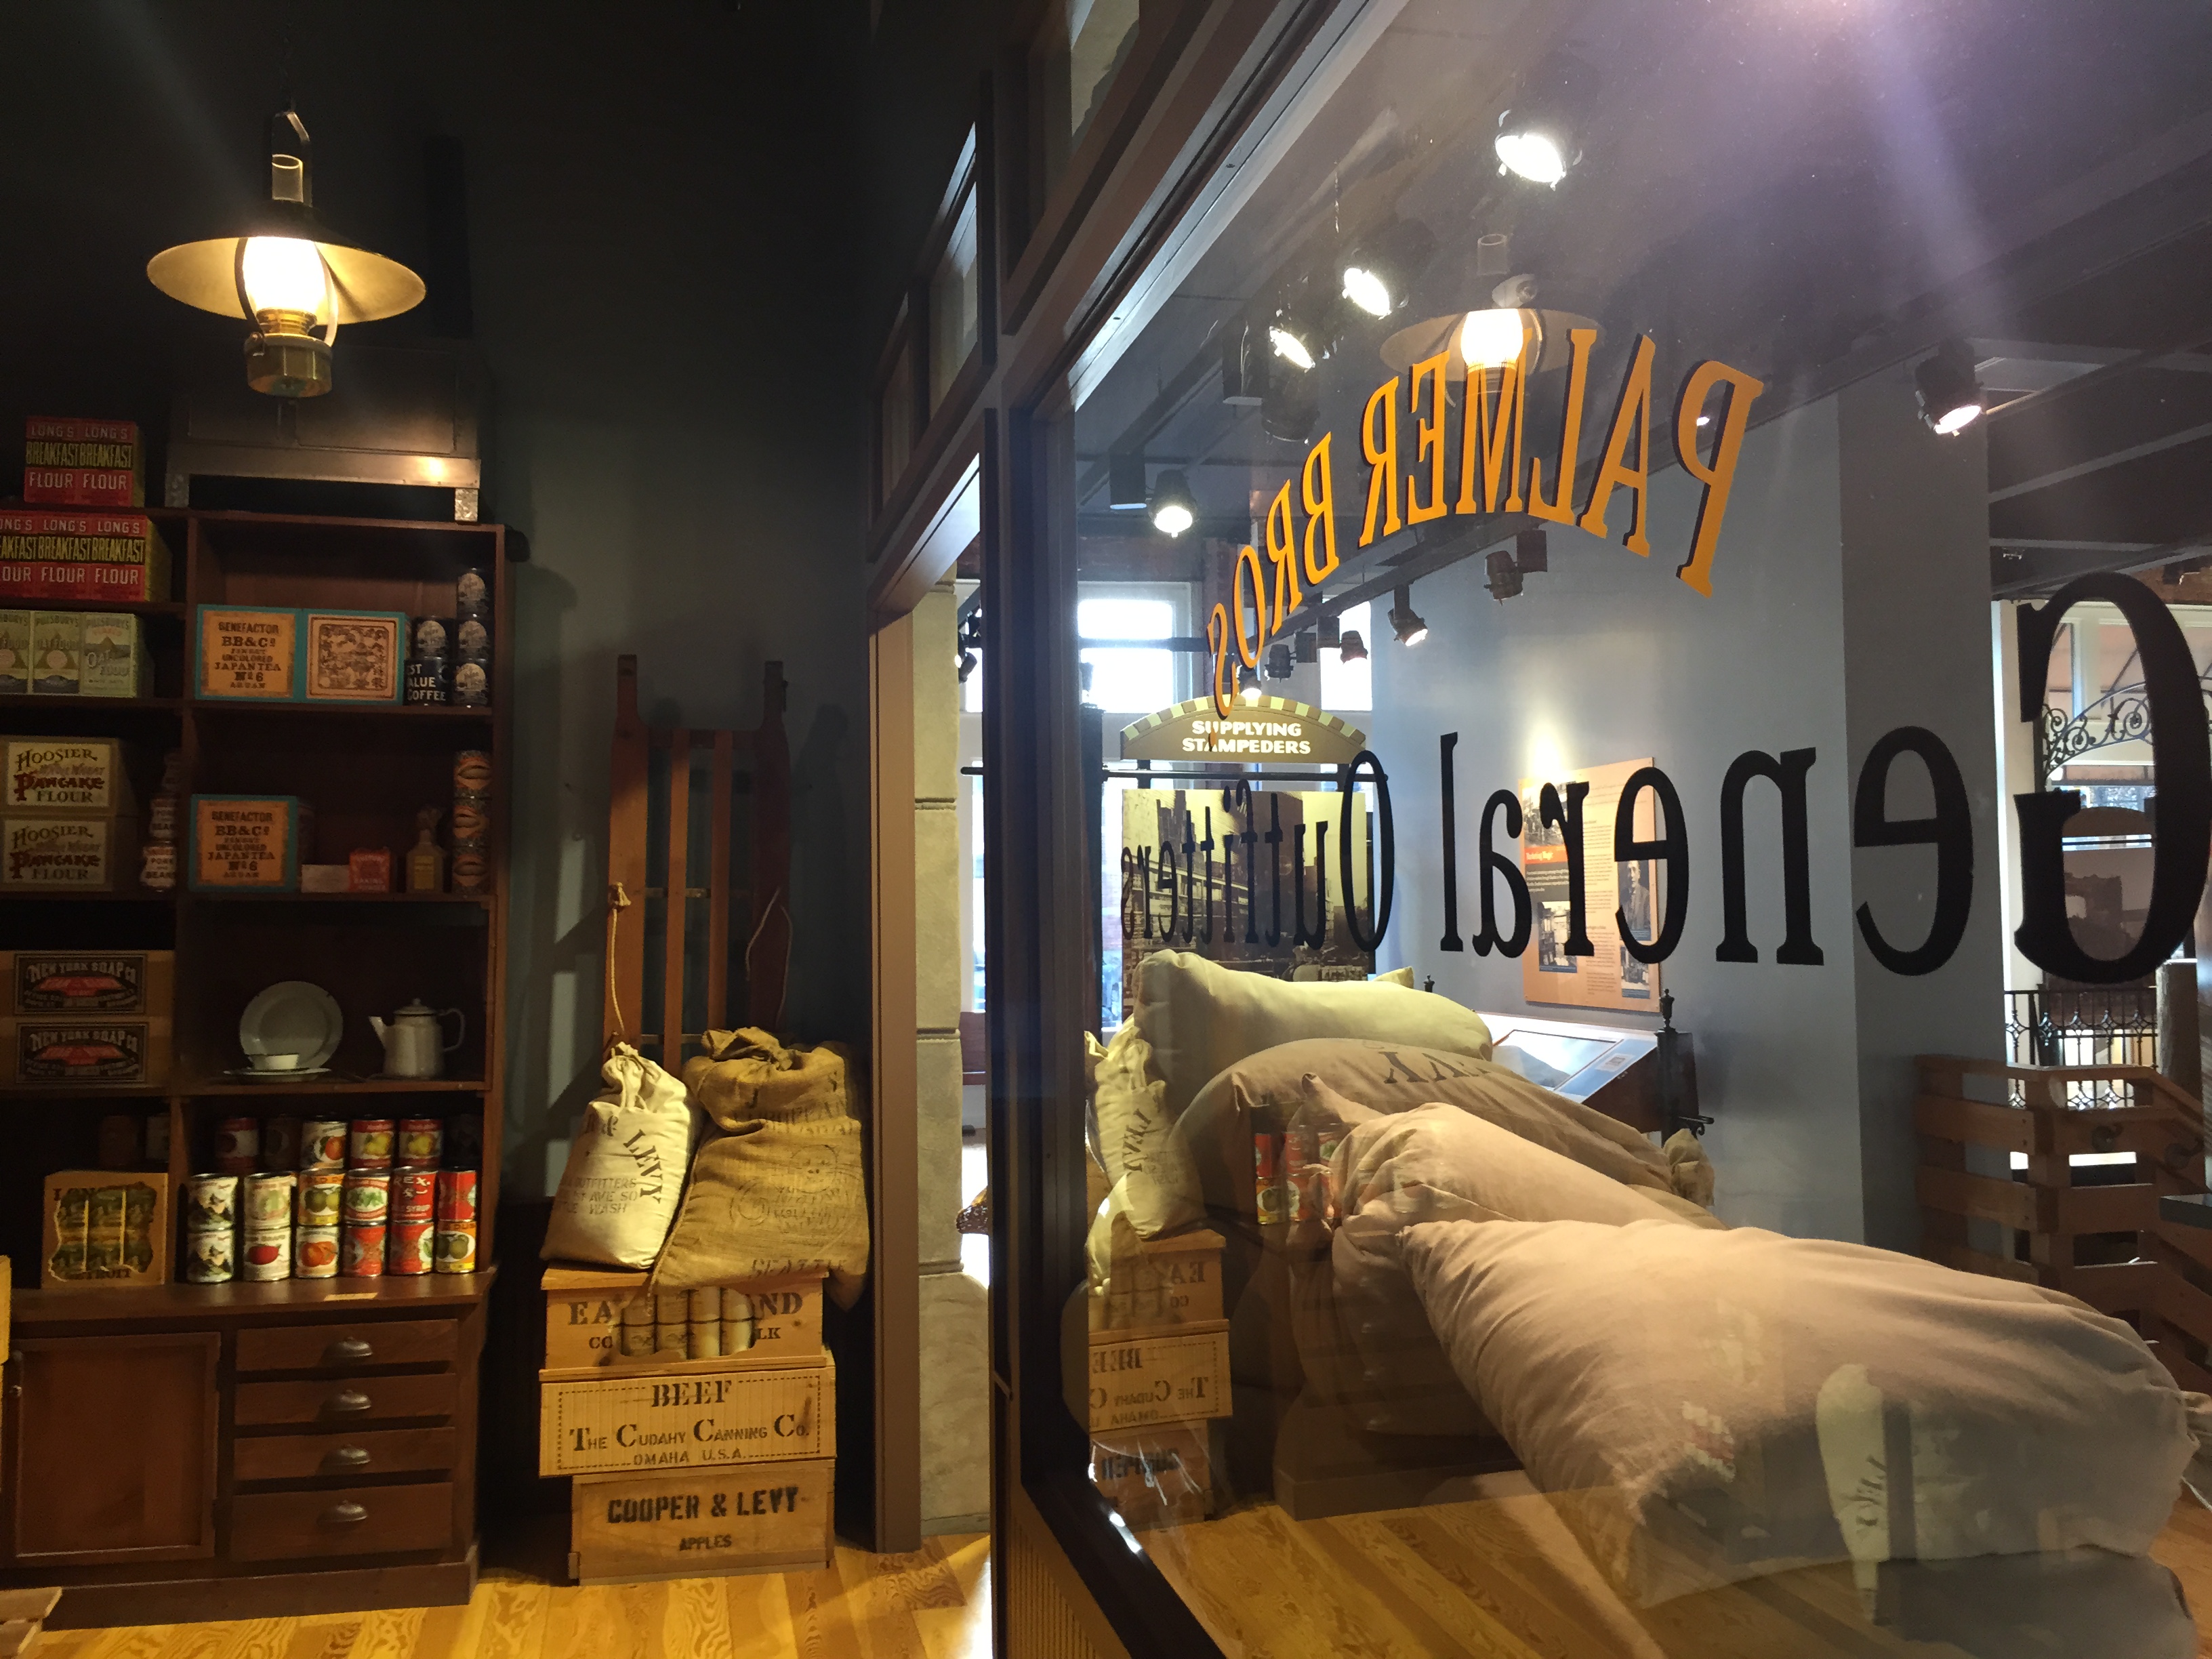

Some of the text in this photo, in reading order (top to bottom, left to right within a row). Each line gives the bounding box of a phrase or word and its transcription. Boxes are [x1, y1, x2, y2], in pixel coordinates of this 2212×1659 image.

[26, 441, 132, 468] BREAKFAST BREAKFAST
[29, 472, 127, 490] FLOUR FLOUR
[37, 536, 91, 560] BREAKFAST
[91, 537, 144, 562] BREAKFAST
[41, 567, 85, 583] FLOUR
[95, 569, 139, 585] FLOUR
[407, 689, 446, 701] COFFEE
[1191, 720, 1303, 737] SUPPLYING
[1183, 737, 1311, 755] STAMPEDERS
[16, 748, 98, 773] HOOSIER
[14, 772, 105, 802] PANCAKE
[36, 791, 94, 802] FLOUR
[12, 825, 94, 849] HOOSIER
[9, 852, 101, 879] PANCAKE
[31, 868, 88, 880] FLOUR
[91, 962, 124, 977] SOAP
[93, 1031, 125, 1046] SOAP
[758, 1292, 803, 1315] ND
[651, 1379, 734, 1408] BEEF
[633, 1451, 690, 1467] OMAHA
[607, 1486, 799, 1525] COOPER & LEVY
[678, 1533, 733, 1552] APPLES
